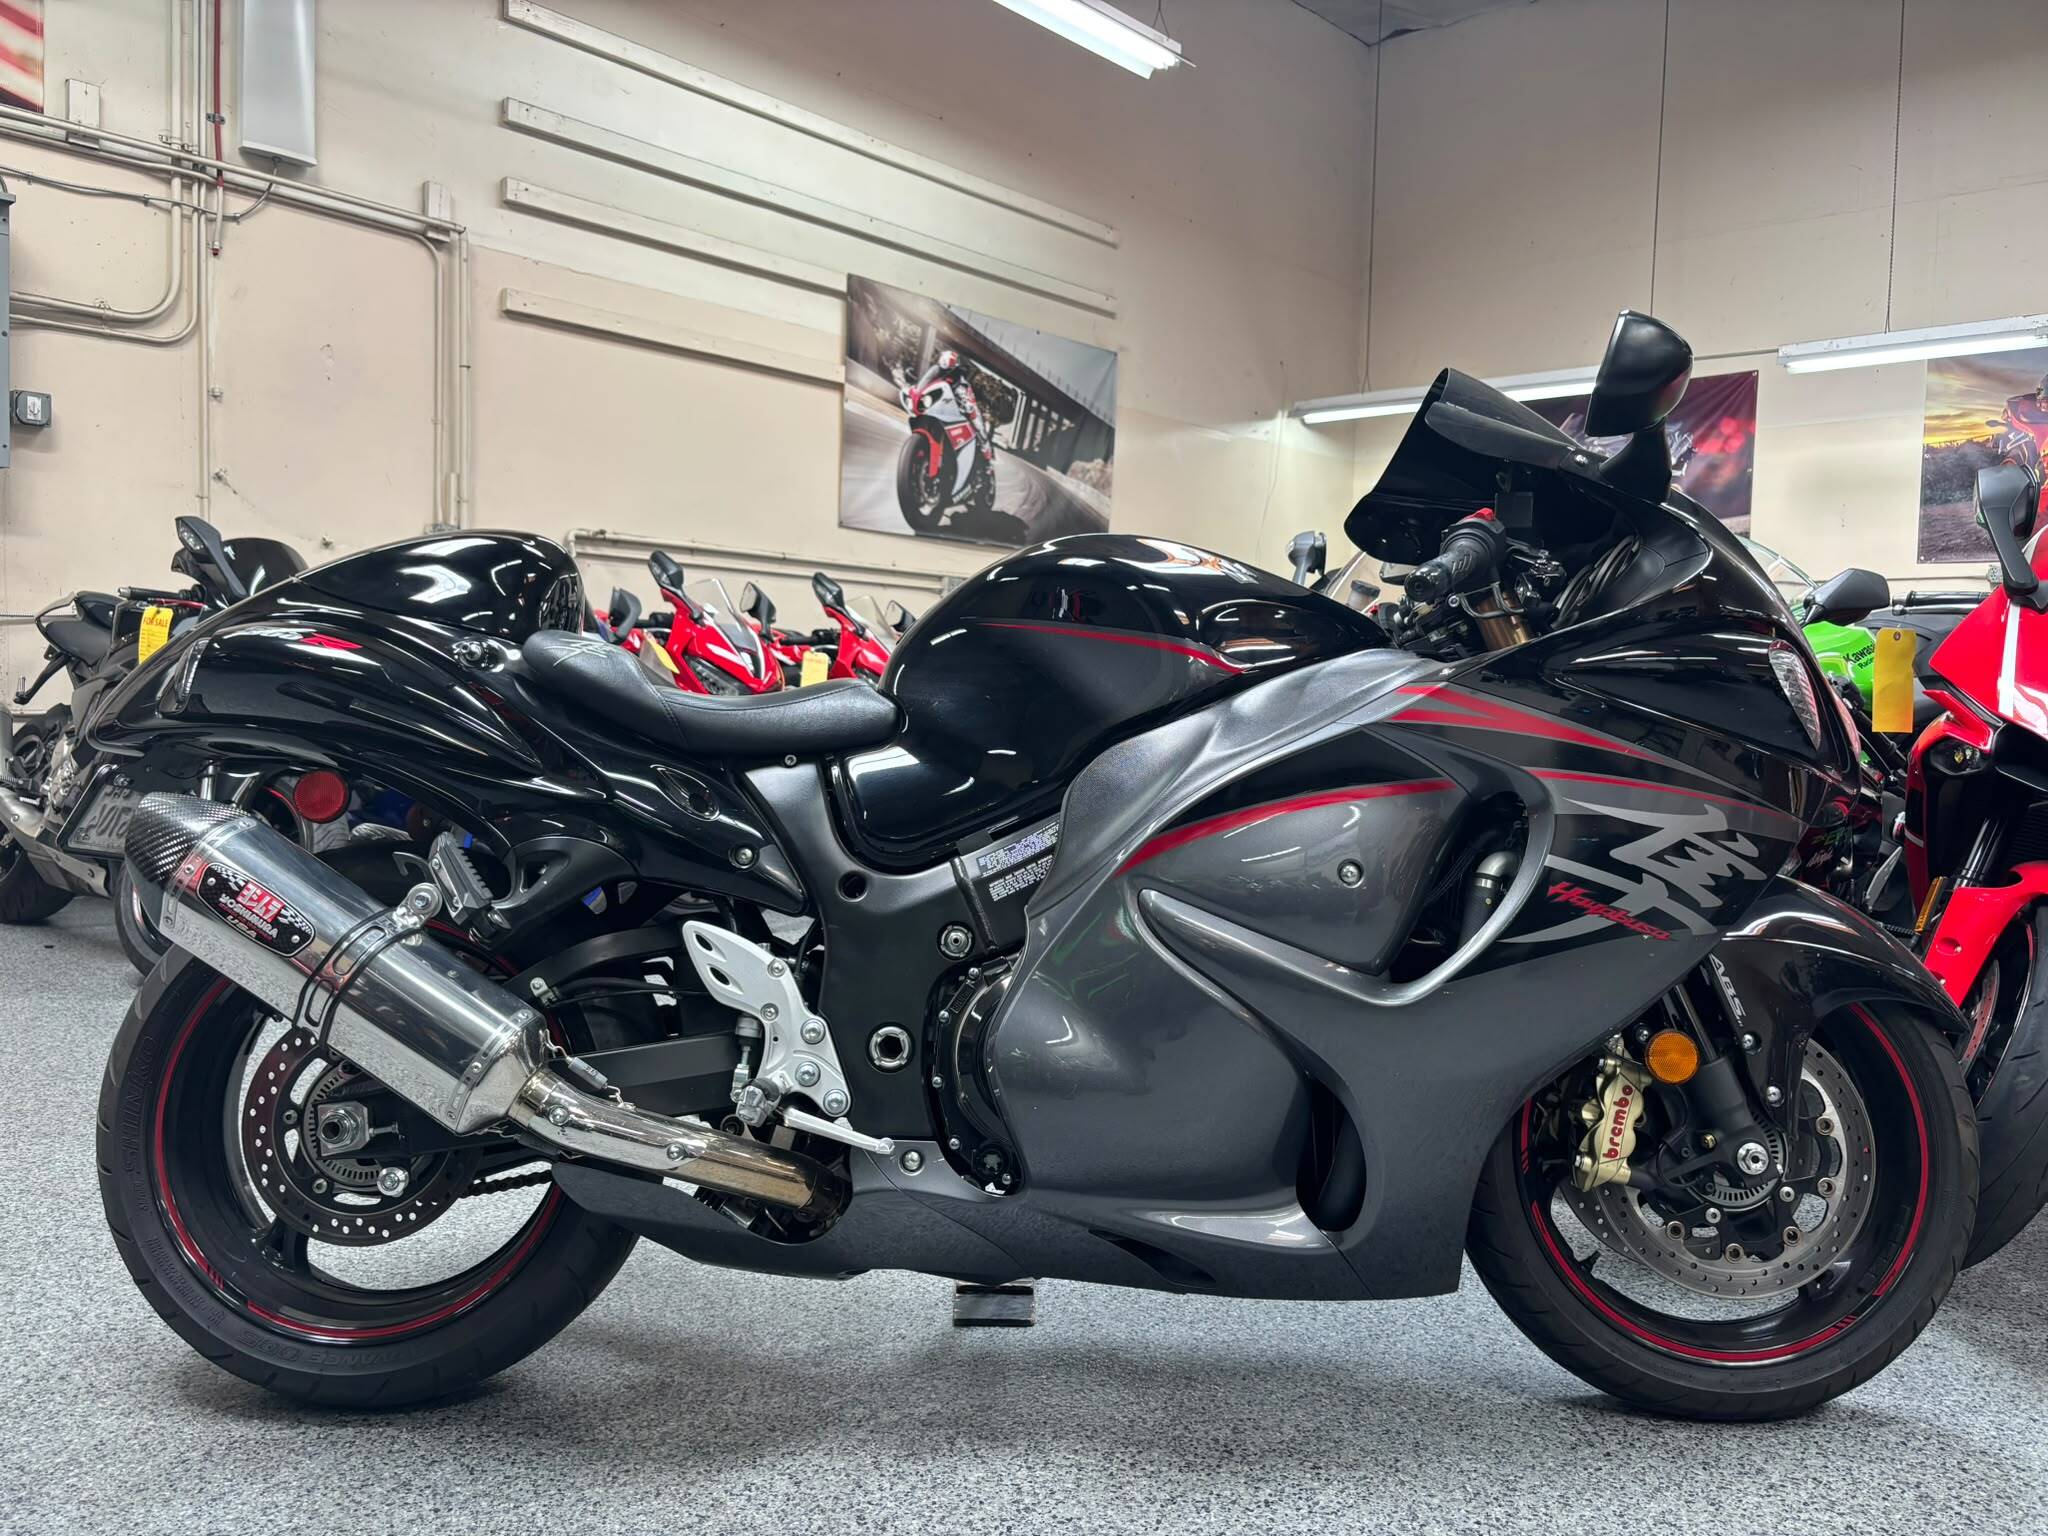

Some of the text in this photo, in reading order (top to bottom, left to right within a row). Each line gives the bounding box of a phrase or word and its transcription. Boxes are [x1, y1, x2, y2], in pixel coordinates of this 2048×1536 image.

[219, 893, 279, 938] YOSHIMURA
[226, 915, 257, 938] USA
[1547, 881, 1671, 940] Hayabusa
[1709, 952, 1746, 1021] ABS
[1602, 1084, 1633, 1159] brembo
